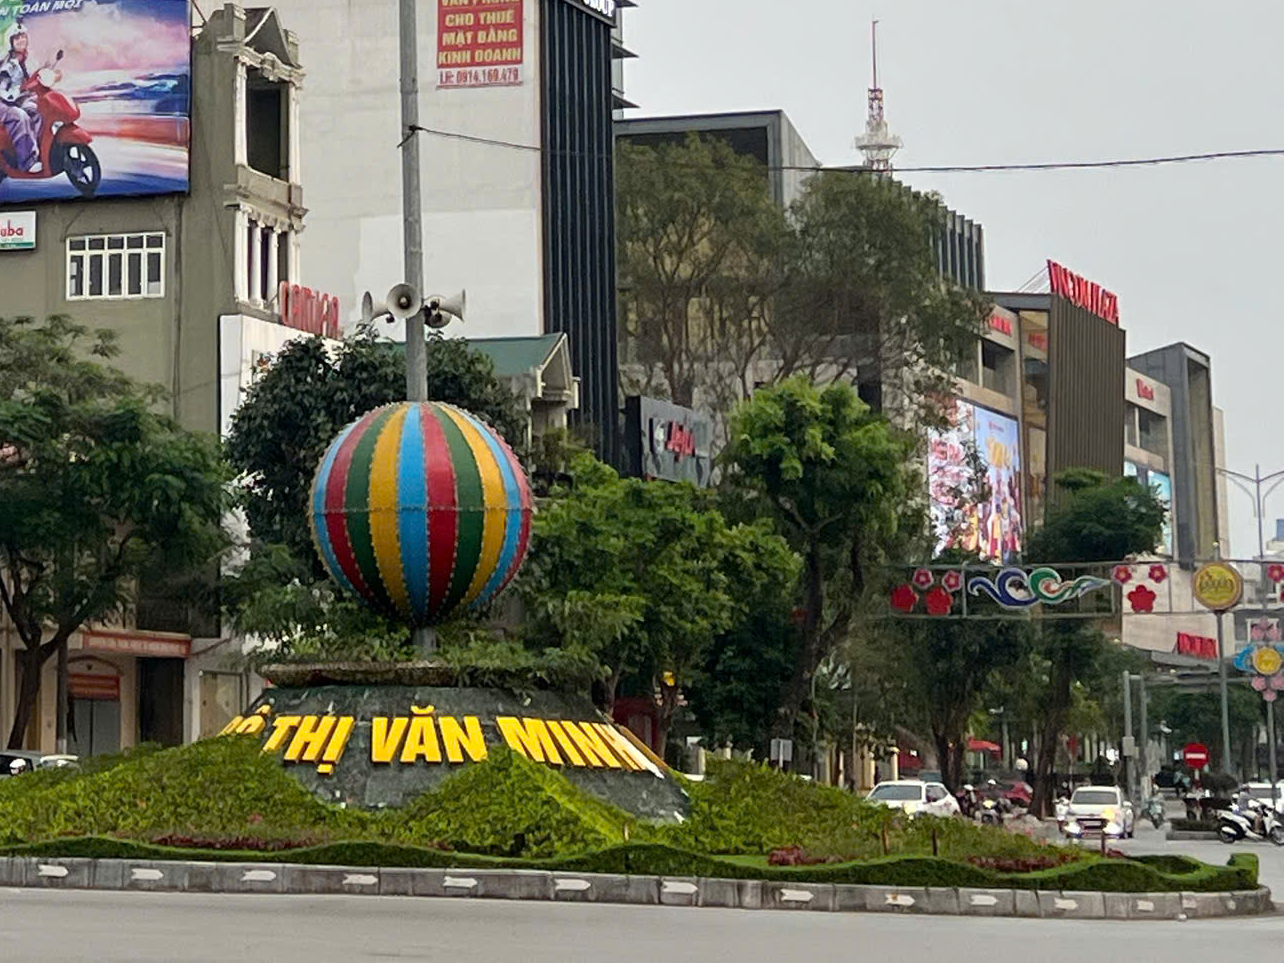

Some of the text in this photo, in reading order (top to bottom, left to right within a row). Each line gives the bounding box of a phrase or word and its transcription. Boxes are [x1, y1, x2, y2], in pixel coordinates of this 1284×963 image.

[444, 8, 515, 27] CHO THUÊ
[441, 27, 518, 48] MẶT BẰNG
[438, 47, 521, 65] KINH DOANH
[259, 715, 356, 775] THỊ
[371, 704, 488, 765] VĂN
[495, 715, 665, 779] MINH
